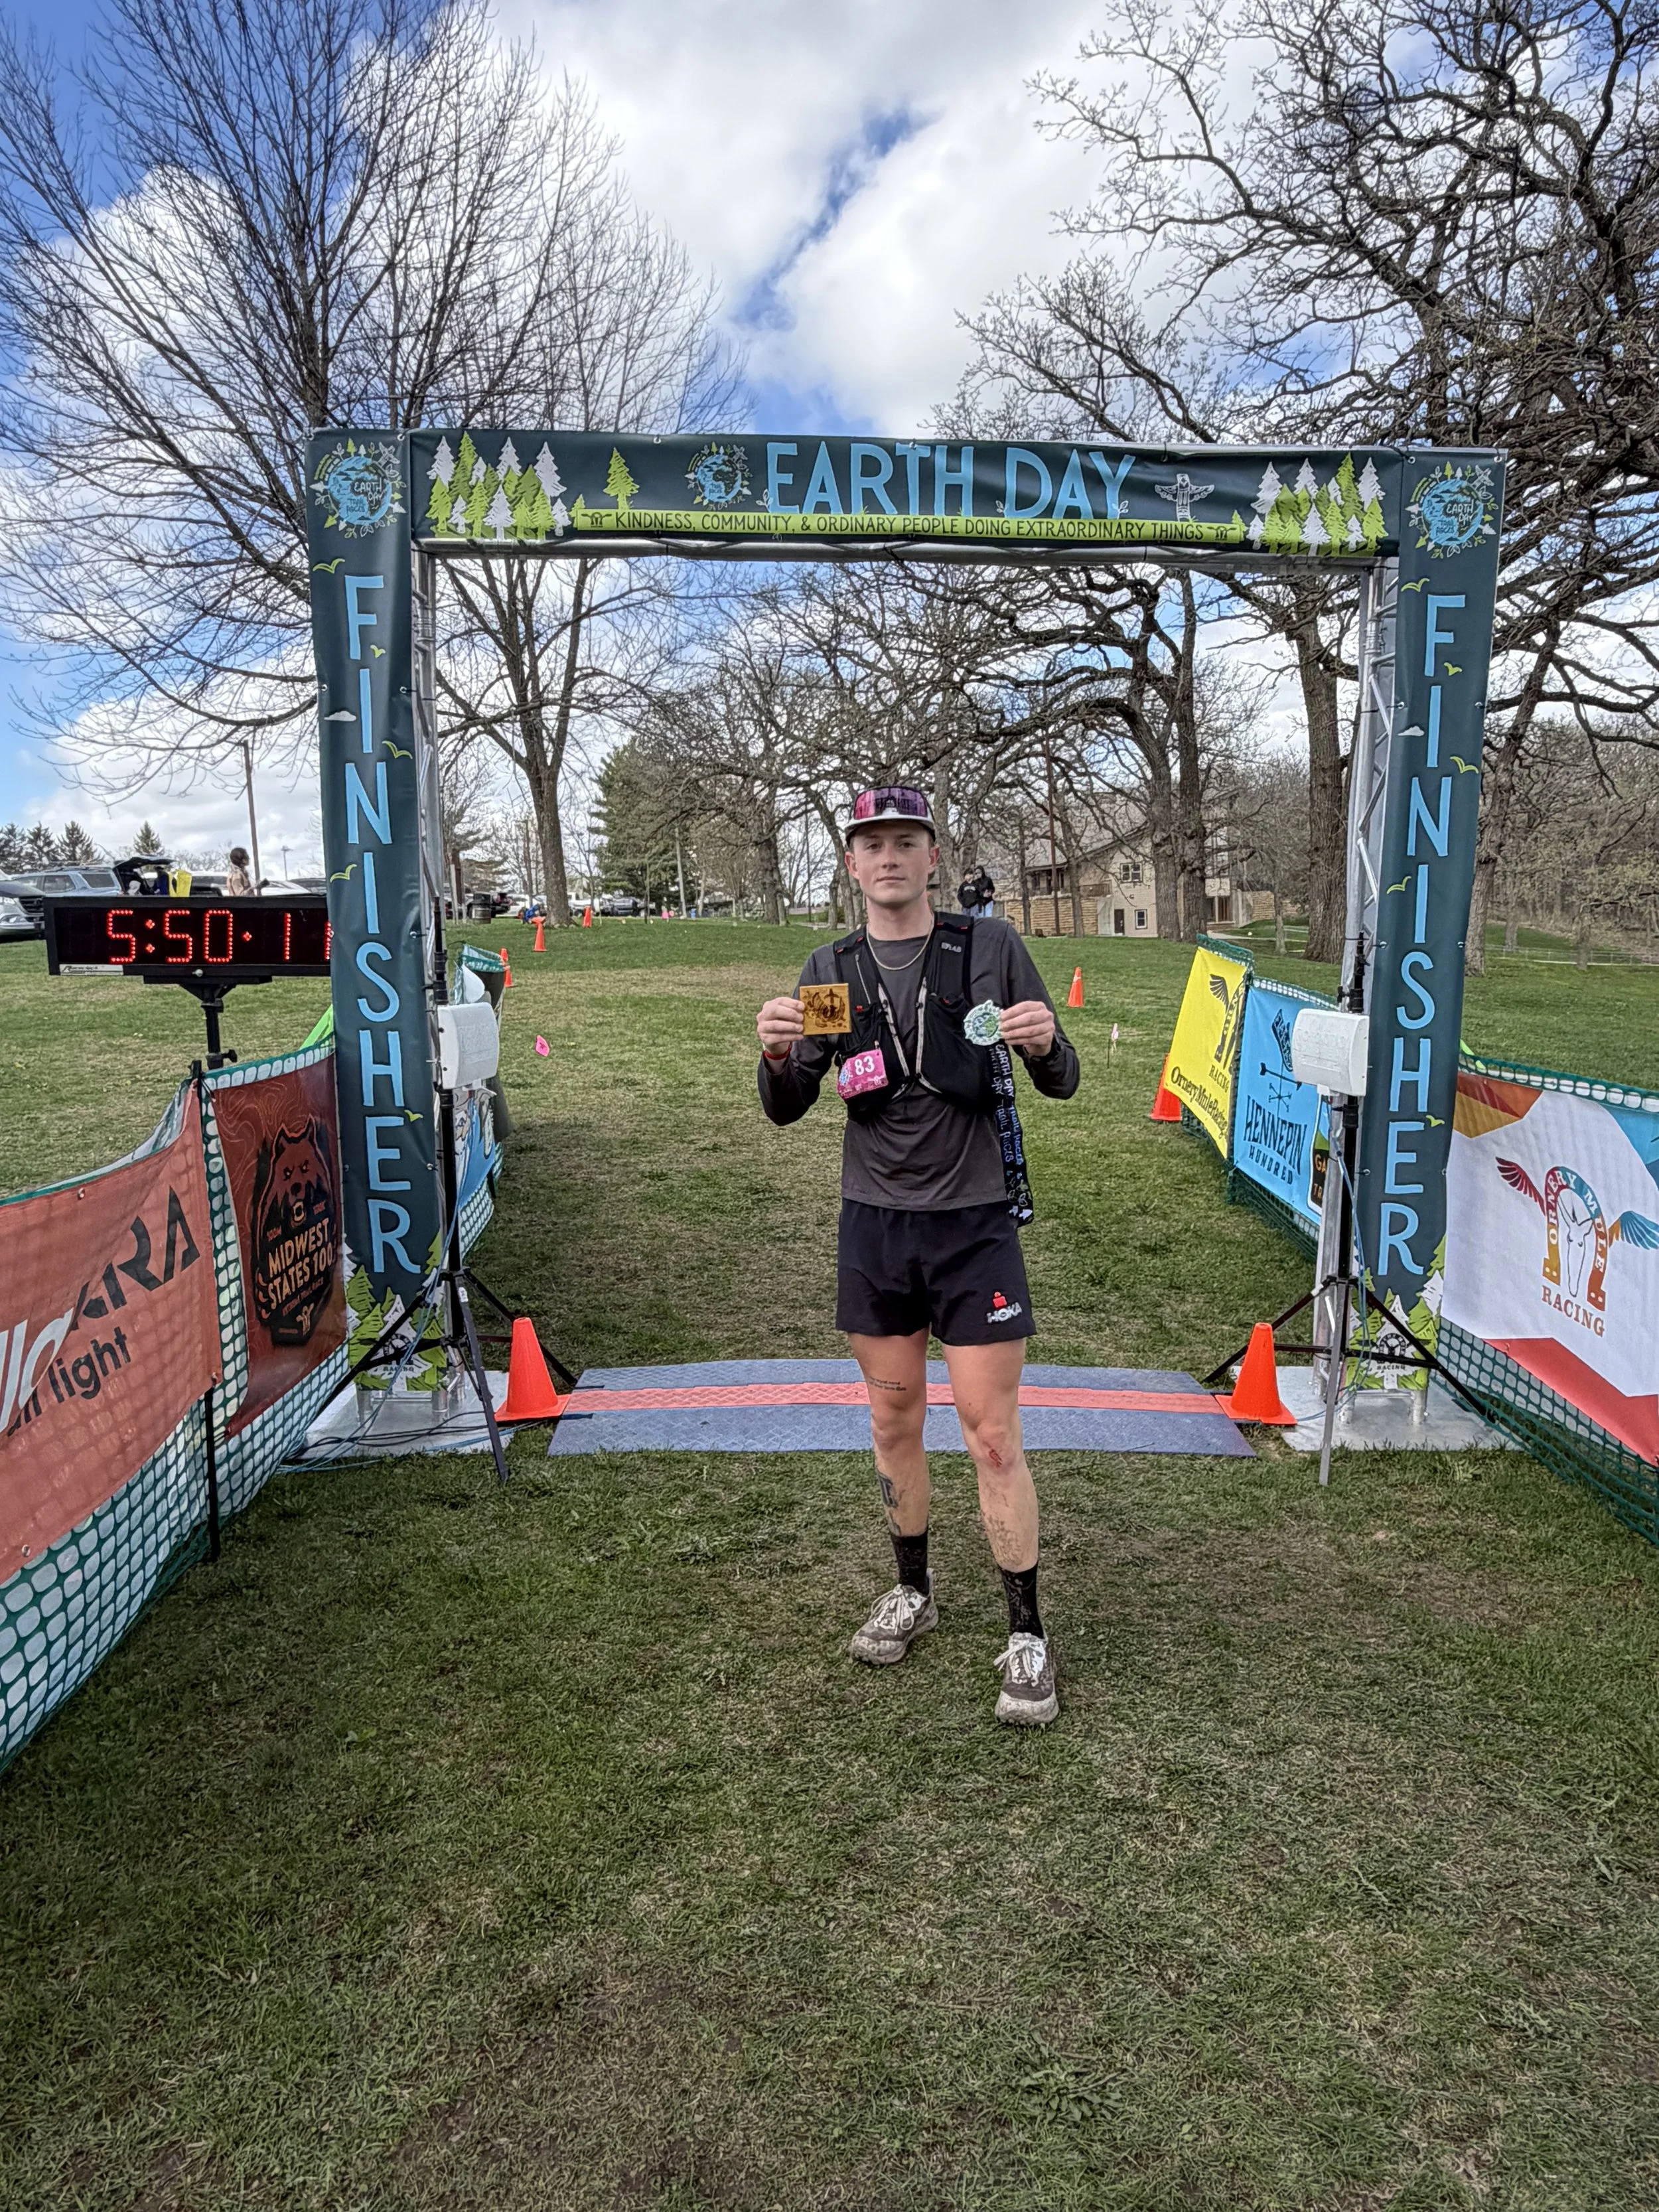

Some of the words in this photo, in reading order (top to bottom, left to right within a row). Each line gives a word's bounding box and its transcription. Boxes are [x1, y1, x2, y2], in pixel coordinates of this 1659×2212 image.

[354, 477, 382, 493] EARTH
[368, 490, 384, 506] DAY
[767, 441, 975, 518] EARTH
[1005, 447, 1137, 520] DAY
[1446, 499, 1474, 514] EARTH
[1458, 513, 1475, 527] DAY
[615, 512, 696, 531] KINDNESS,
[701, 513, 796, 533] COMMUNITY,
[800, 516, 811, 531] &
[816, 516, 897, 533] ORDINARY
[902, 518, 959, 534] PEOPLE
[965, 519, 1011, 536] DOING
[1016, 520, 1147, 540] EXTRAORDINARY
[1151, 522, 1203, 541] THINGS
[344, 575, 422, 1274] FINISHER
[1378, 594, 1466, 1276] FINISHER
[854, 1055, 875, 1076] 83
[995, 1044, 1013, 1076] EARTH
[1003, 1078, 1015, 1098] DAY
[1243, 1095, 1308, 1176] HENNEPIN
[1248, 1144, 1293, 1185] HUNDRED
[1547, 1169, 1577, 1246] ORNERY
[1583, 1188, 1607, 1274] MULE
[267, 1217, 330, 1278] MIDWEST
[267, 1256, 311, 1310] STATES
[313, 1242, 332, 1276] 100
[986, 1301, 1023, 1323] HOKA
[1541, 1284, 1605, 1339] RACING
